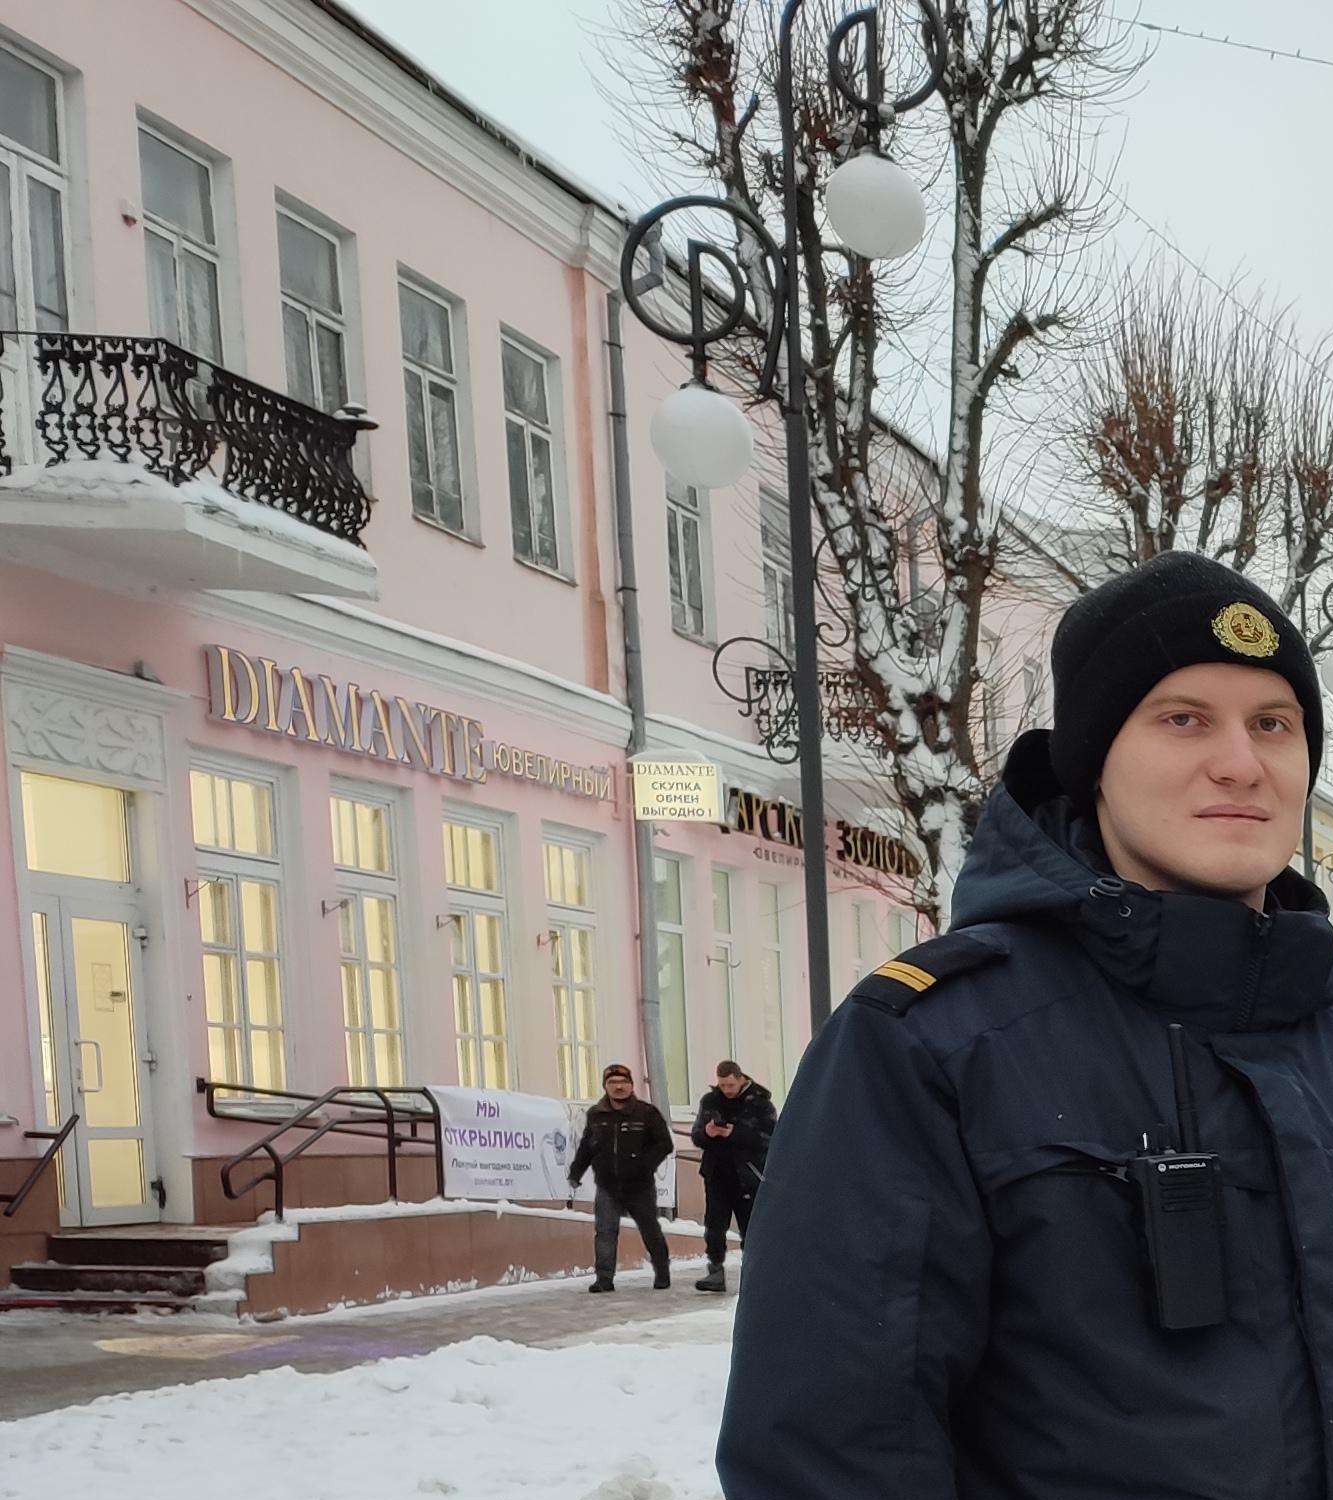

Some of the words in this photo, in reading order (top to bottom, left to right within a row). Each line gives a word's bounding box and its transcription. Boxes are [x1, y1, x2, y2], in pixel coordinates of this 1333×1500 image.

[208, 644, 488, 784] DIAMANTE
[492, 741, 611, 801] ЮВЕЛИРНЫЙ
[636, 763, 715, 777] DIAMANTE
[651, 780, 702, 792] СКУПКА
[655, 793, 700, 804] ОБМЕН
[476, 1100, 500, 1119] МЫ
[444, 1127, 535, 1150] ОТКРЫЛИСЬ!
